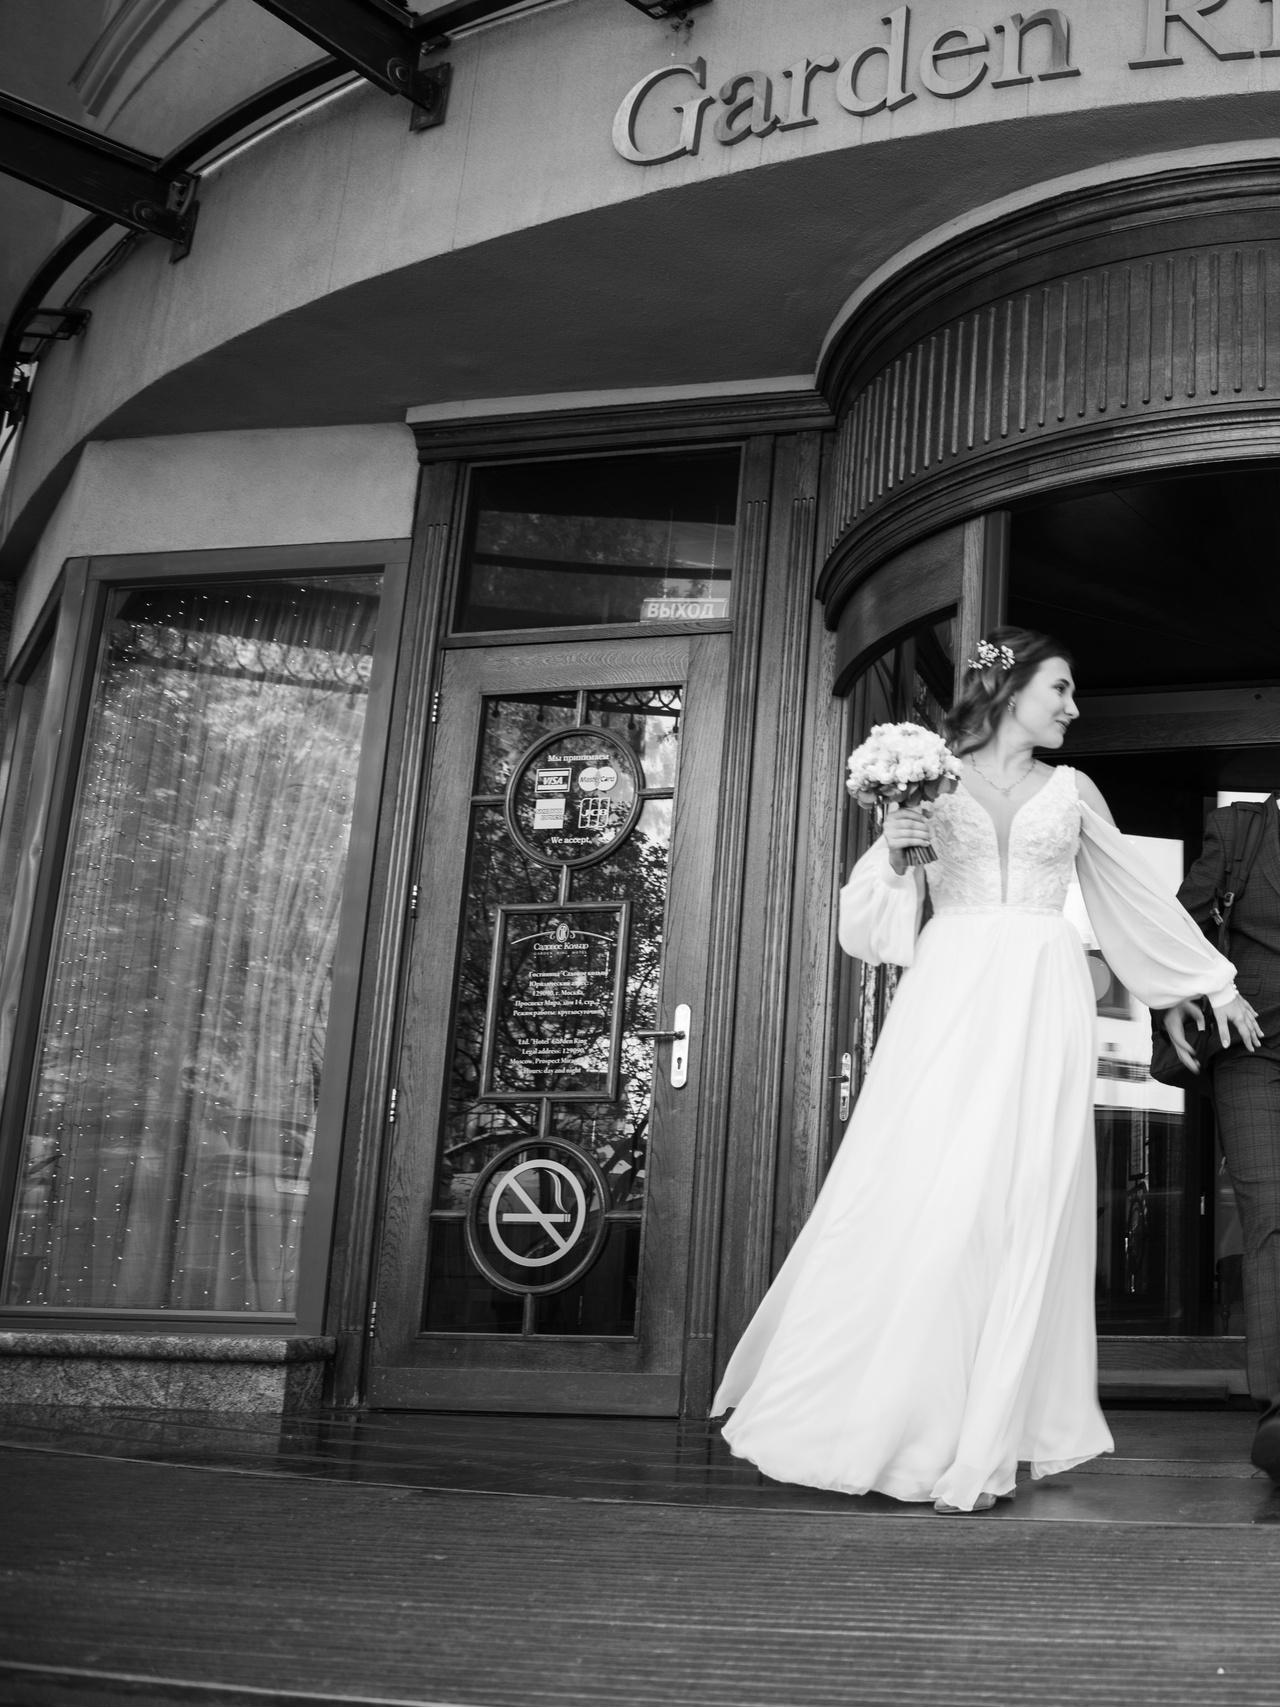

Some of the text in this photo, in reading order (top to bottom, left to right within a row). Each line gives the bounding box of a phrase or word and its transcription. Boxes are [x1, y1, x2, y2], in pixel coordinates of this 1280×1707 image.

[612, 6, 1080, 165] Garden
[647, 603, 714, 618] ВЫХОД
[563, 754, 610, 763] принимаем
[543, 776, 563, 785] VISA
[581, 809, 608, 817] JCB
[522, 1048, 537, 1056] Legal
[535, 1058, 560, 1066] Prospect
[543, 1067, 554, 1075] day
[565, 1067, 581, 1075] night
